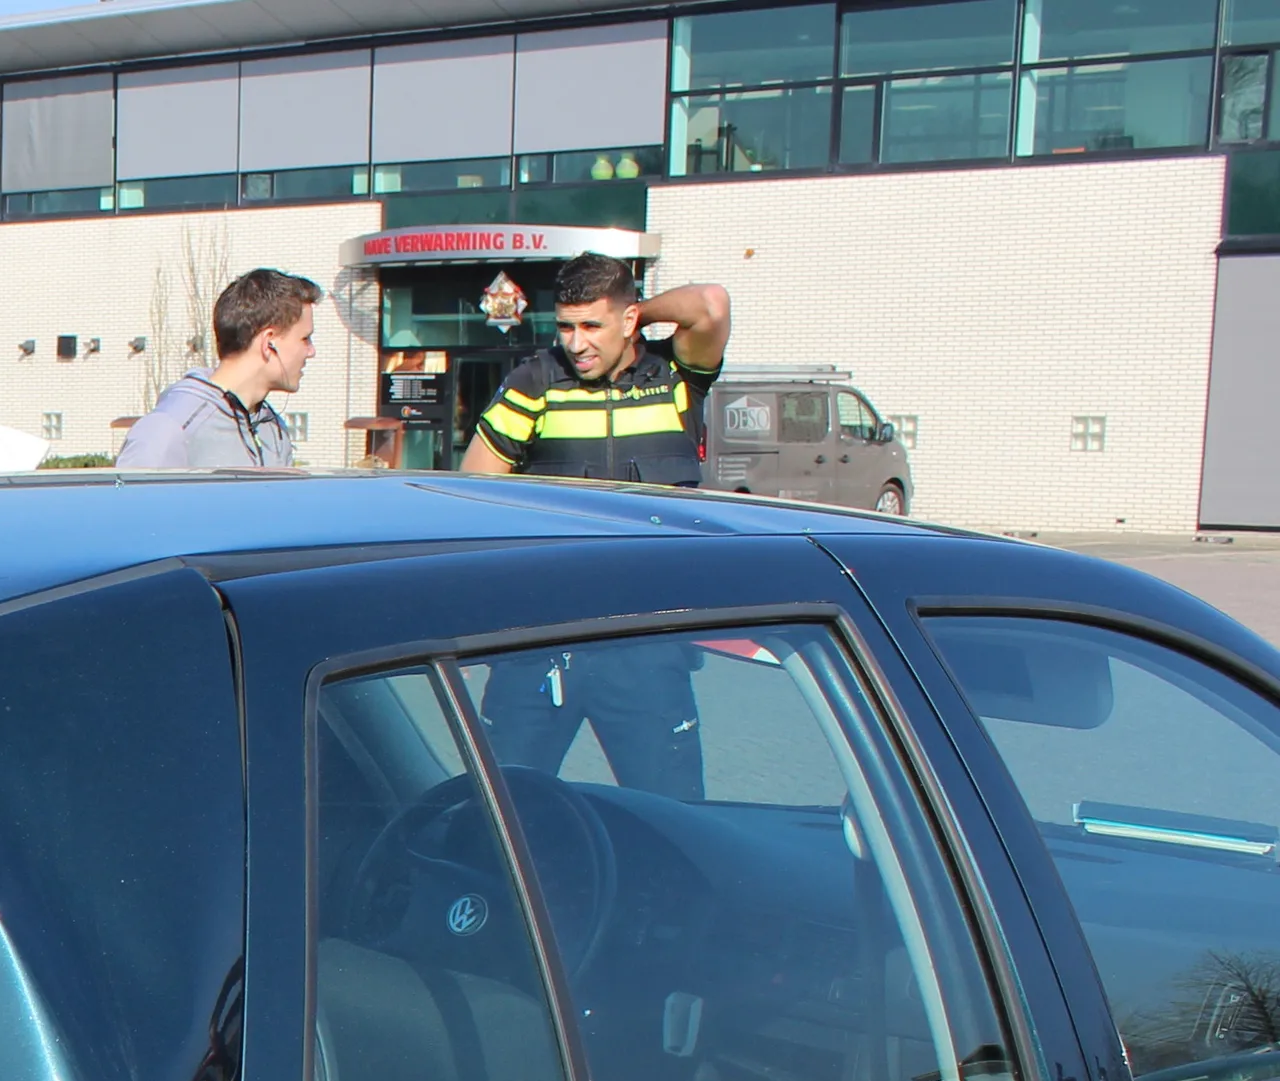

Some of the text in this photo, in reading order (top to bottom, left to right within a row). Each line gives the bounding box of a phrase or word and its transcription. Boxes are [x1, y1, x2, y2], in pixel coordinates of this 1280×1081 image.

[394, 232, 505, 254] VERWARMING
[512, 233, 549, 250] B.V.
[726, 407, 770, 431] DESO
